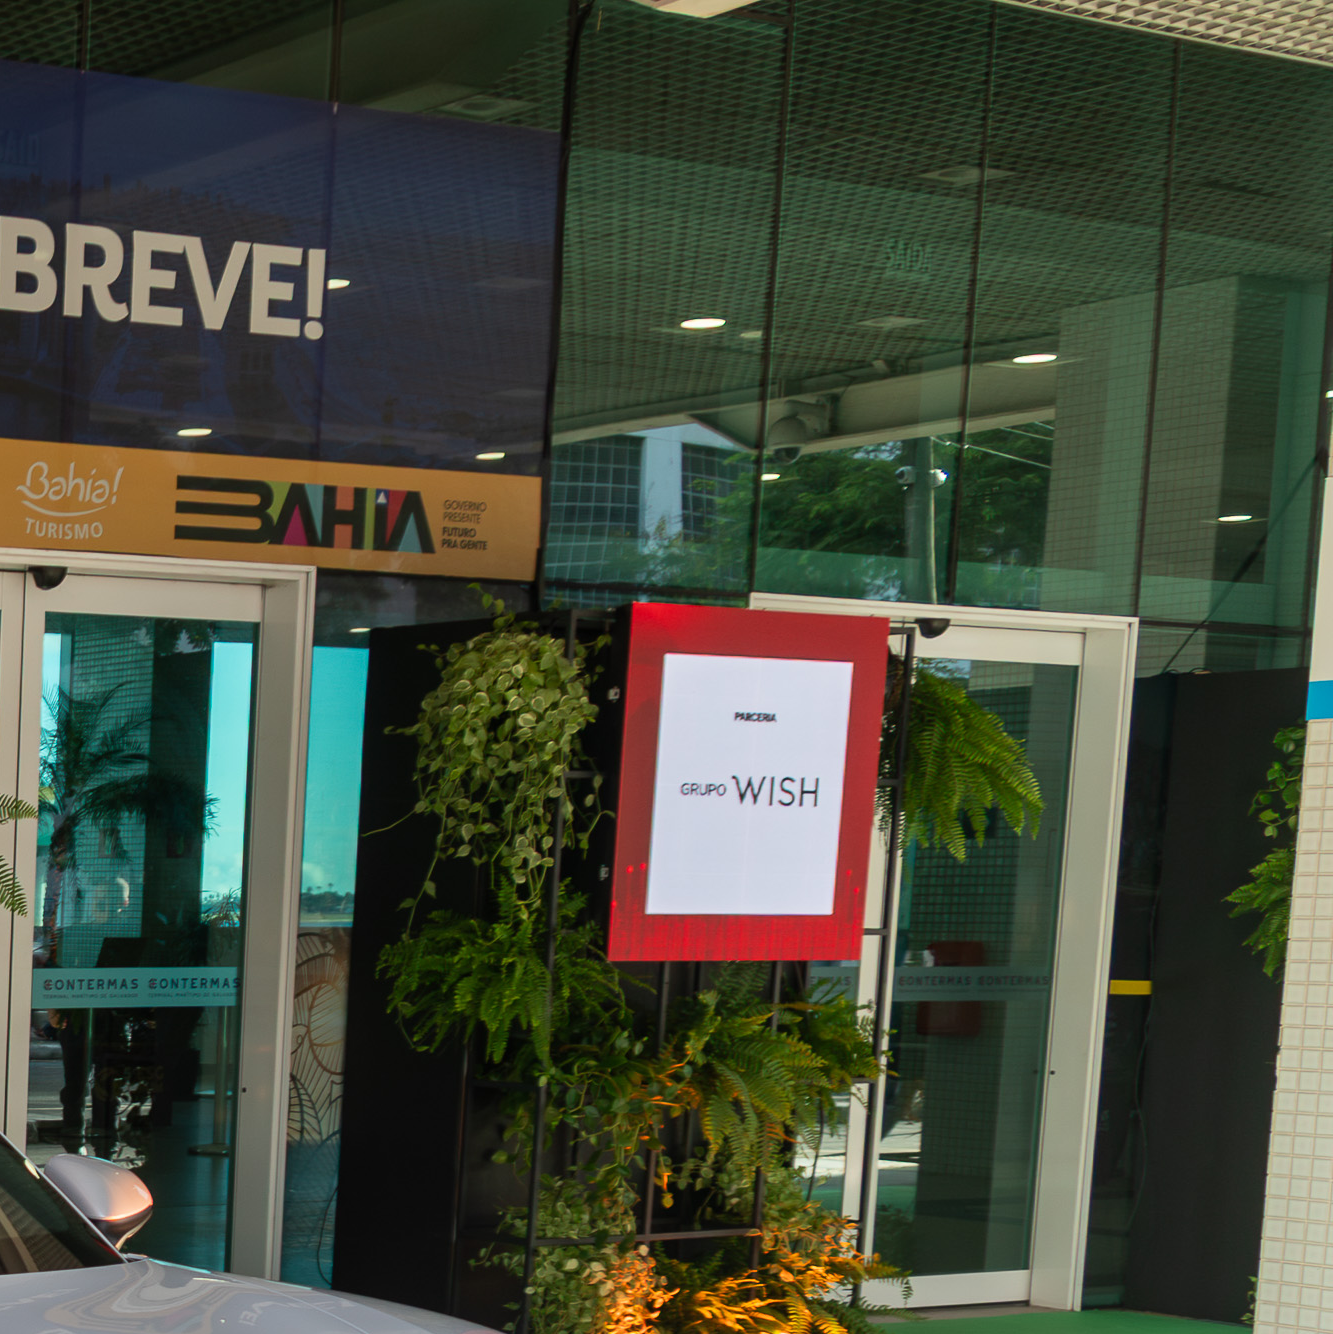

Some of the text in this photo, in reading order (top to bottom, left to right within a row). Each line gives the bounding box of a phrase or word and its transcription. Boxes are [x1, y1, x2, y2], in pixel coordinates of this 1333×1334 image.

[444, 499, 488, 512] GOVERNO
[174, 475, 436, 555] BAHIA
[443, 512, 482, 524] PRESENTE
[25, 517, 104, 540] TURISMO
[442, 526, 477, 538] FUTURO
[460, 539, 488, 551] GENTE
[734, 712, 777, 722] PARCERIA
[681, 775, 819, 807] GRUPO WISH
[43, 977, 242, 991] CONTERMAS CONTERMAS
